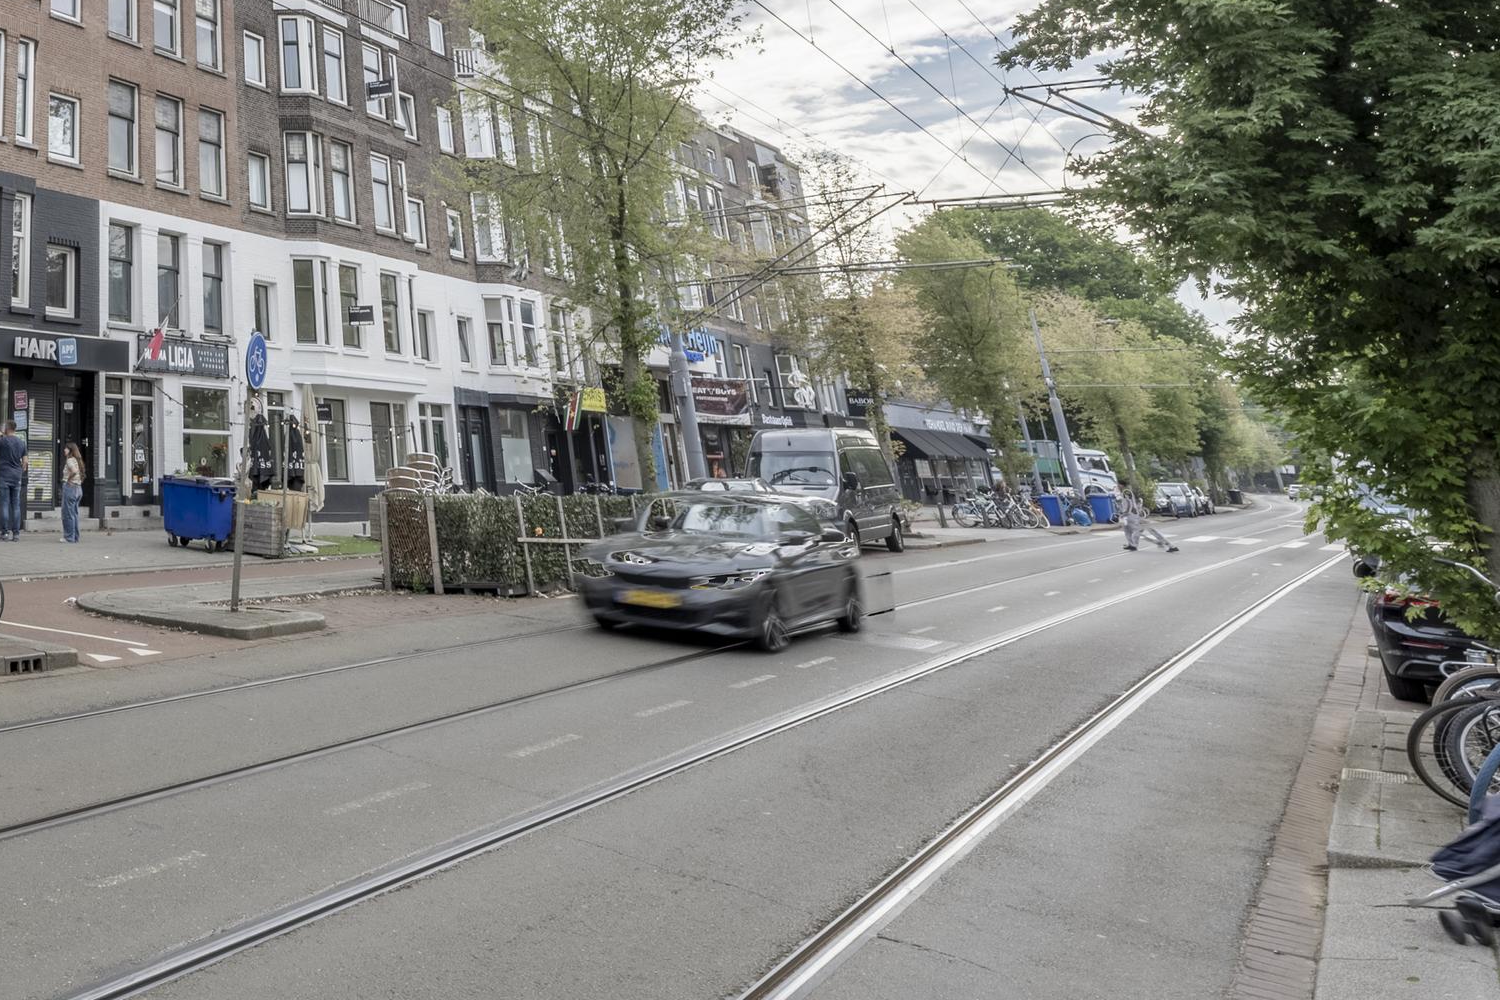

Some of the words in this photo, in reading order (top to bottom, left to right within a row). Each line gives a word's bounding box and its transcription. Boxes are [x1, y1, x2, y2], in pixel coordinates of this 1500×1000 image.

[14, 336, 57, 360] HAIR
[61, 344, 75, 354] APP
[168, 345, 195, 369] LICIA
